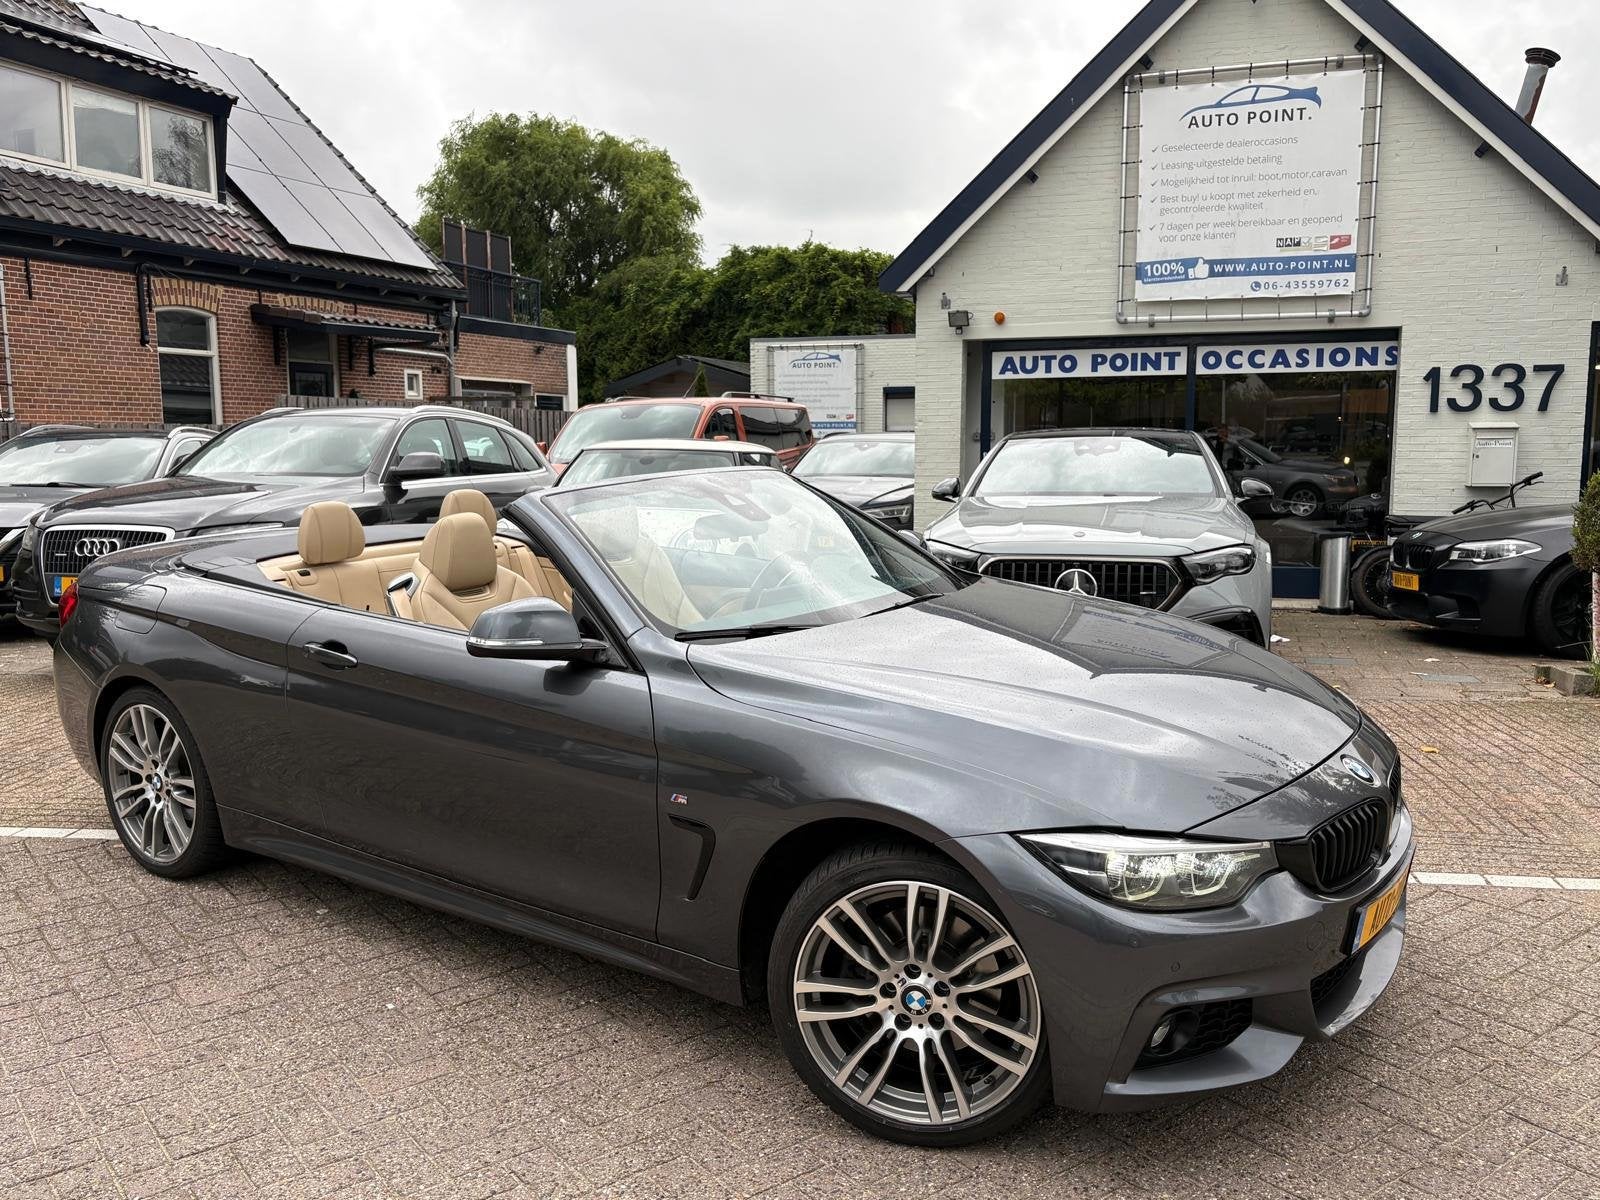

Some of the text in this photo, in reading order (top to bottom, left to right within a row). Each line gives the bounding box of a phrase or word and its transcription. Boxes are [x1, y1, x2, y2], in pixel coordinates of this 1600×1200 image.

[1187, 112, 1239, 129] AUTO
[1161, 136, 1299, 153] Geselecteerde dealeroccasions
[1161, 154, 1283, 171] Leasing-uitgestelde betaling
[1160, 176, 1215, 188] Mogelijkheid
[1217, 175, 1229, 184] tot
[1160, 194, 1179, 204] Best
[1181, 193, 1200, 204] buy!
[1209, 192, 1235, 203] koopt
[1237, 191, 1255, 199] met
[1257, 187, 1301, 199] zekerheid
[1159, 202, 1264, 217] gecontroleerde kwaliteit
[1159, 212, 1343, 232] 7 dagen per week bereikbaar en geopend
[1158, 231, 1236, 243] voor onze klanten
[1144, 261, 1185, 277] 100%
[1213, 259, 1350, 273] WWW.AUTO-POINT.NL
[1263, 278, 1349, 290] 06-43559762
[999, 351, 1182, 375] AUTO POINT
[1201, 345, 1398, 370] OCCASIONS
[1422, 363, 1566, 413] 1337
